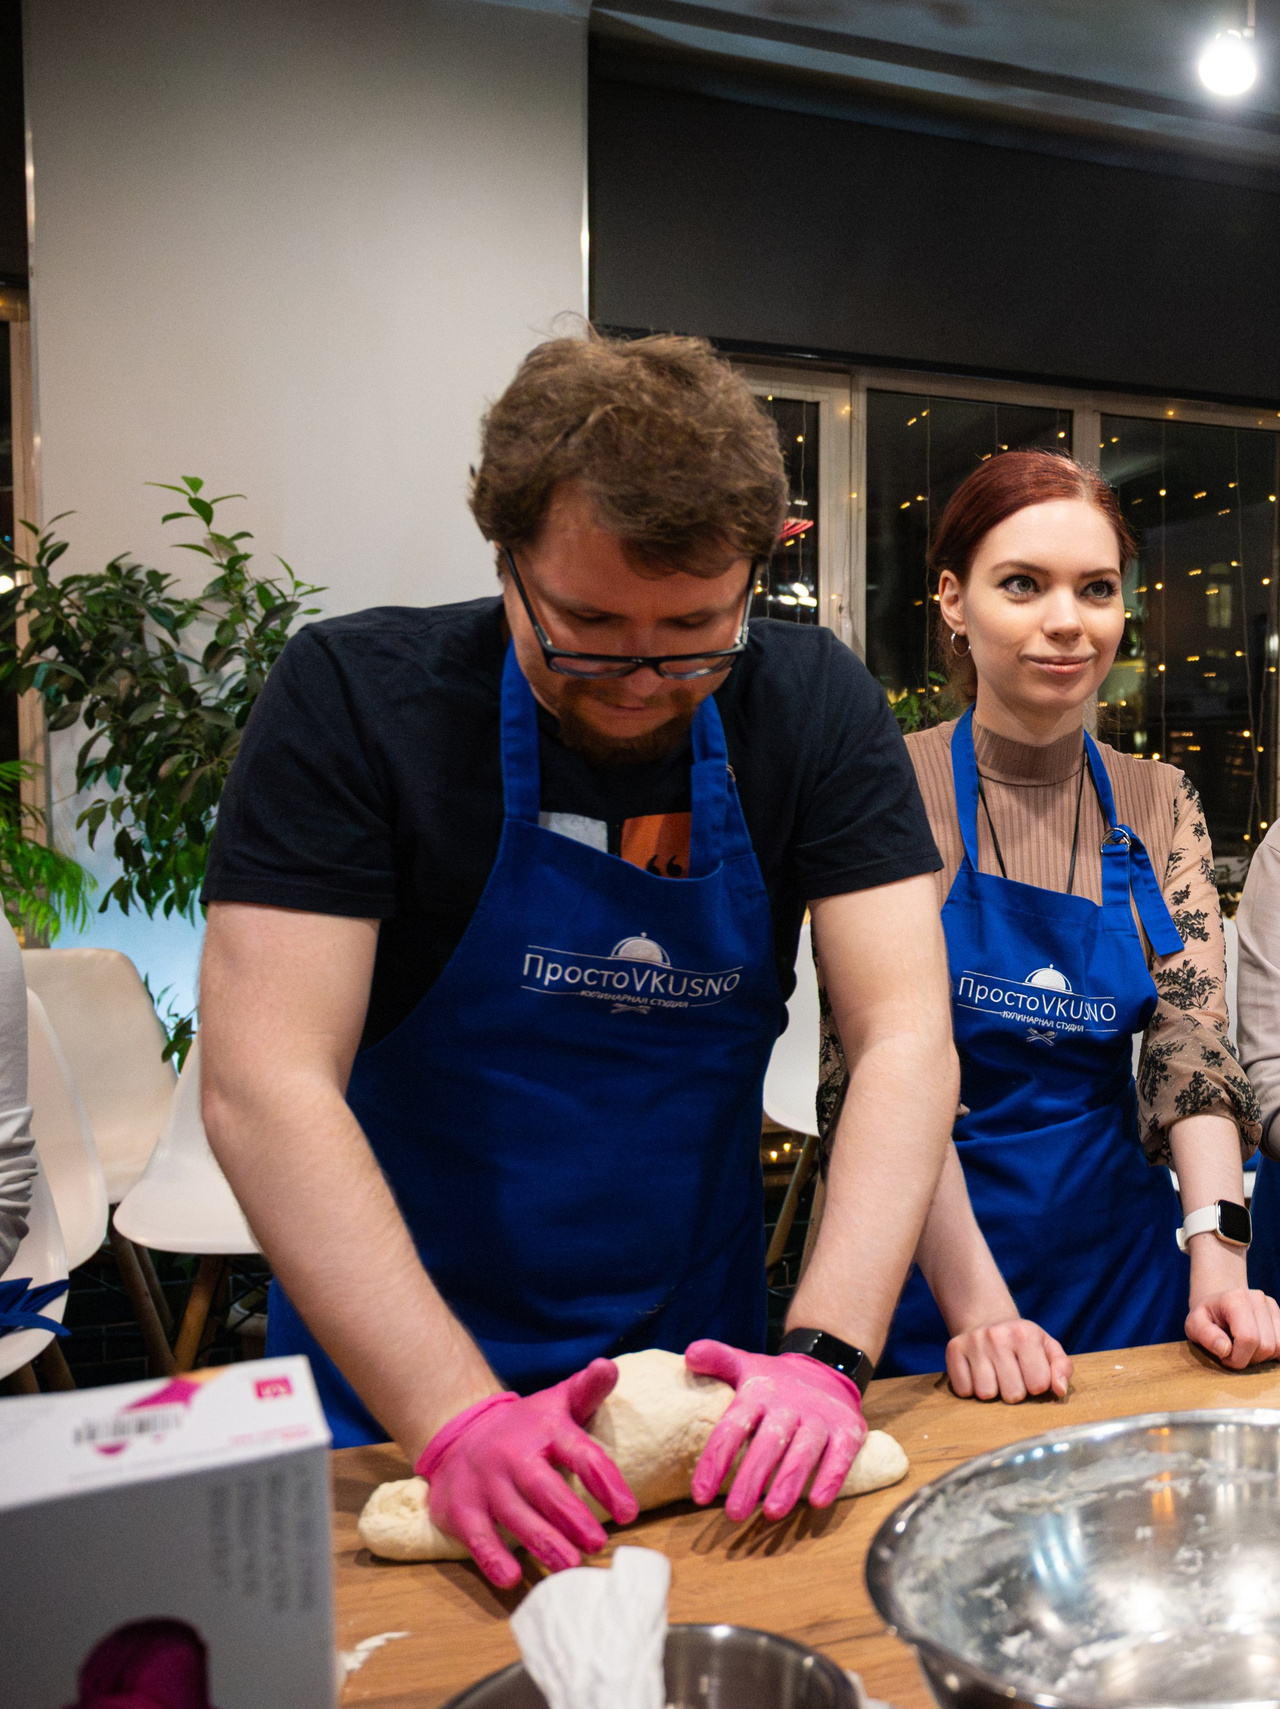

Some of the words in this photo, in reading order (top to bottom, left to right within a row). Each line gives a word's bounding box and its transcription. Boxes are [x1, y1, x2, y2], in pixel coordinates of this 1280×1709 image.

[522, 953, 740, 997] ПростоVKUSNO
[1002, 1010, 1054, 1029] КУЛИНАРНАЯ
[1055, 1021, 1085, 1033] СТУДИЯ
